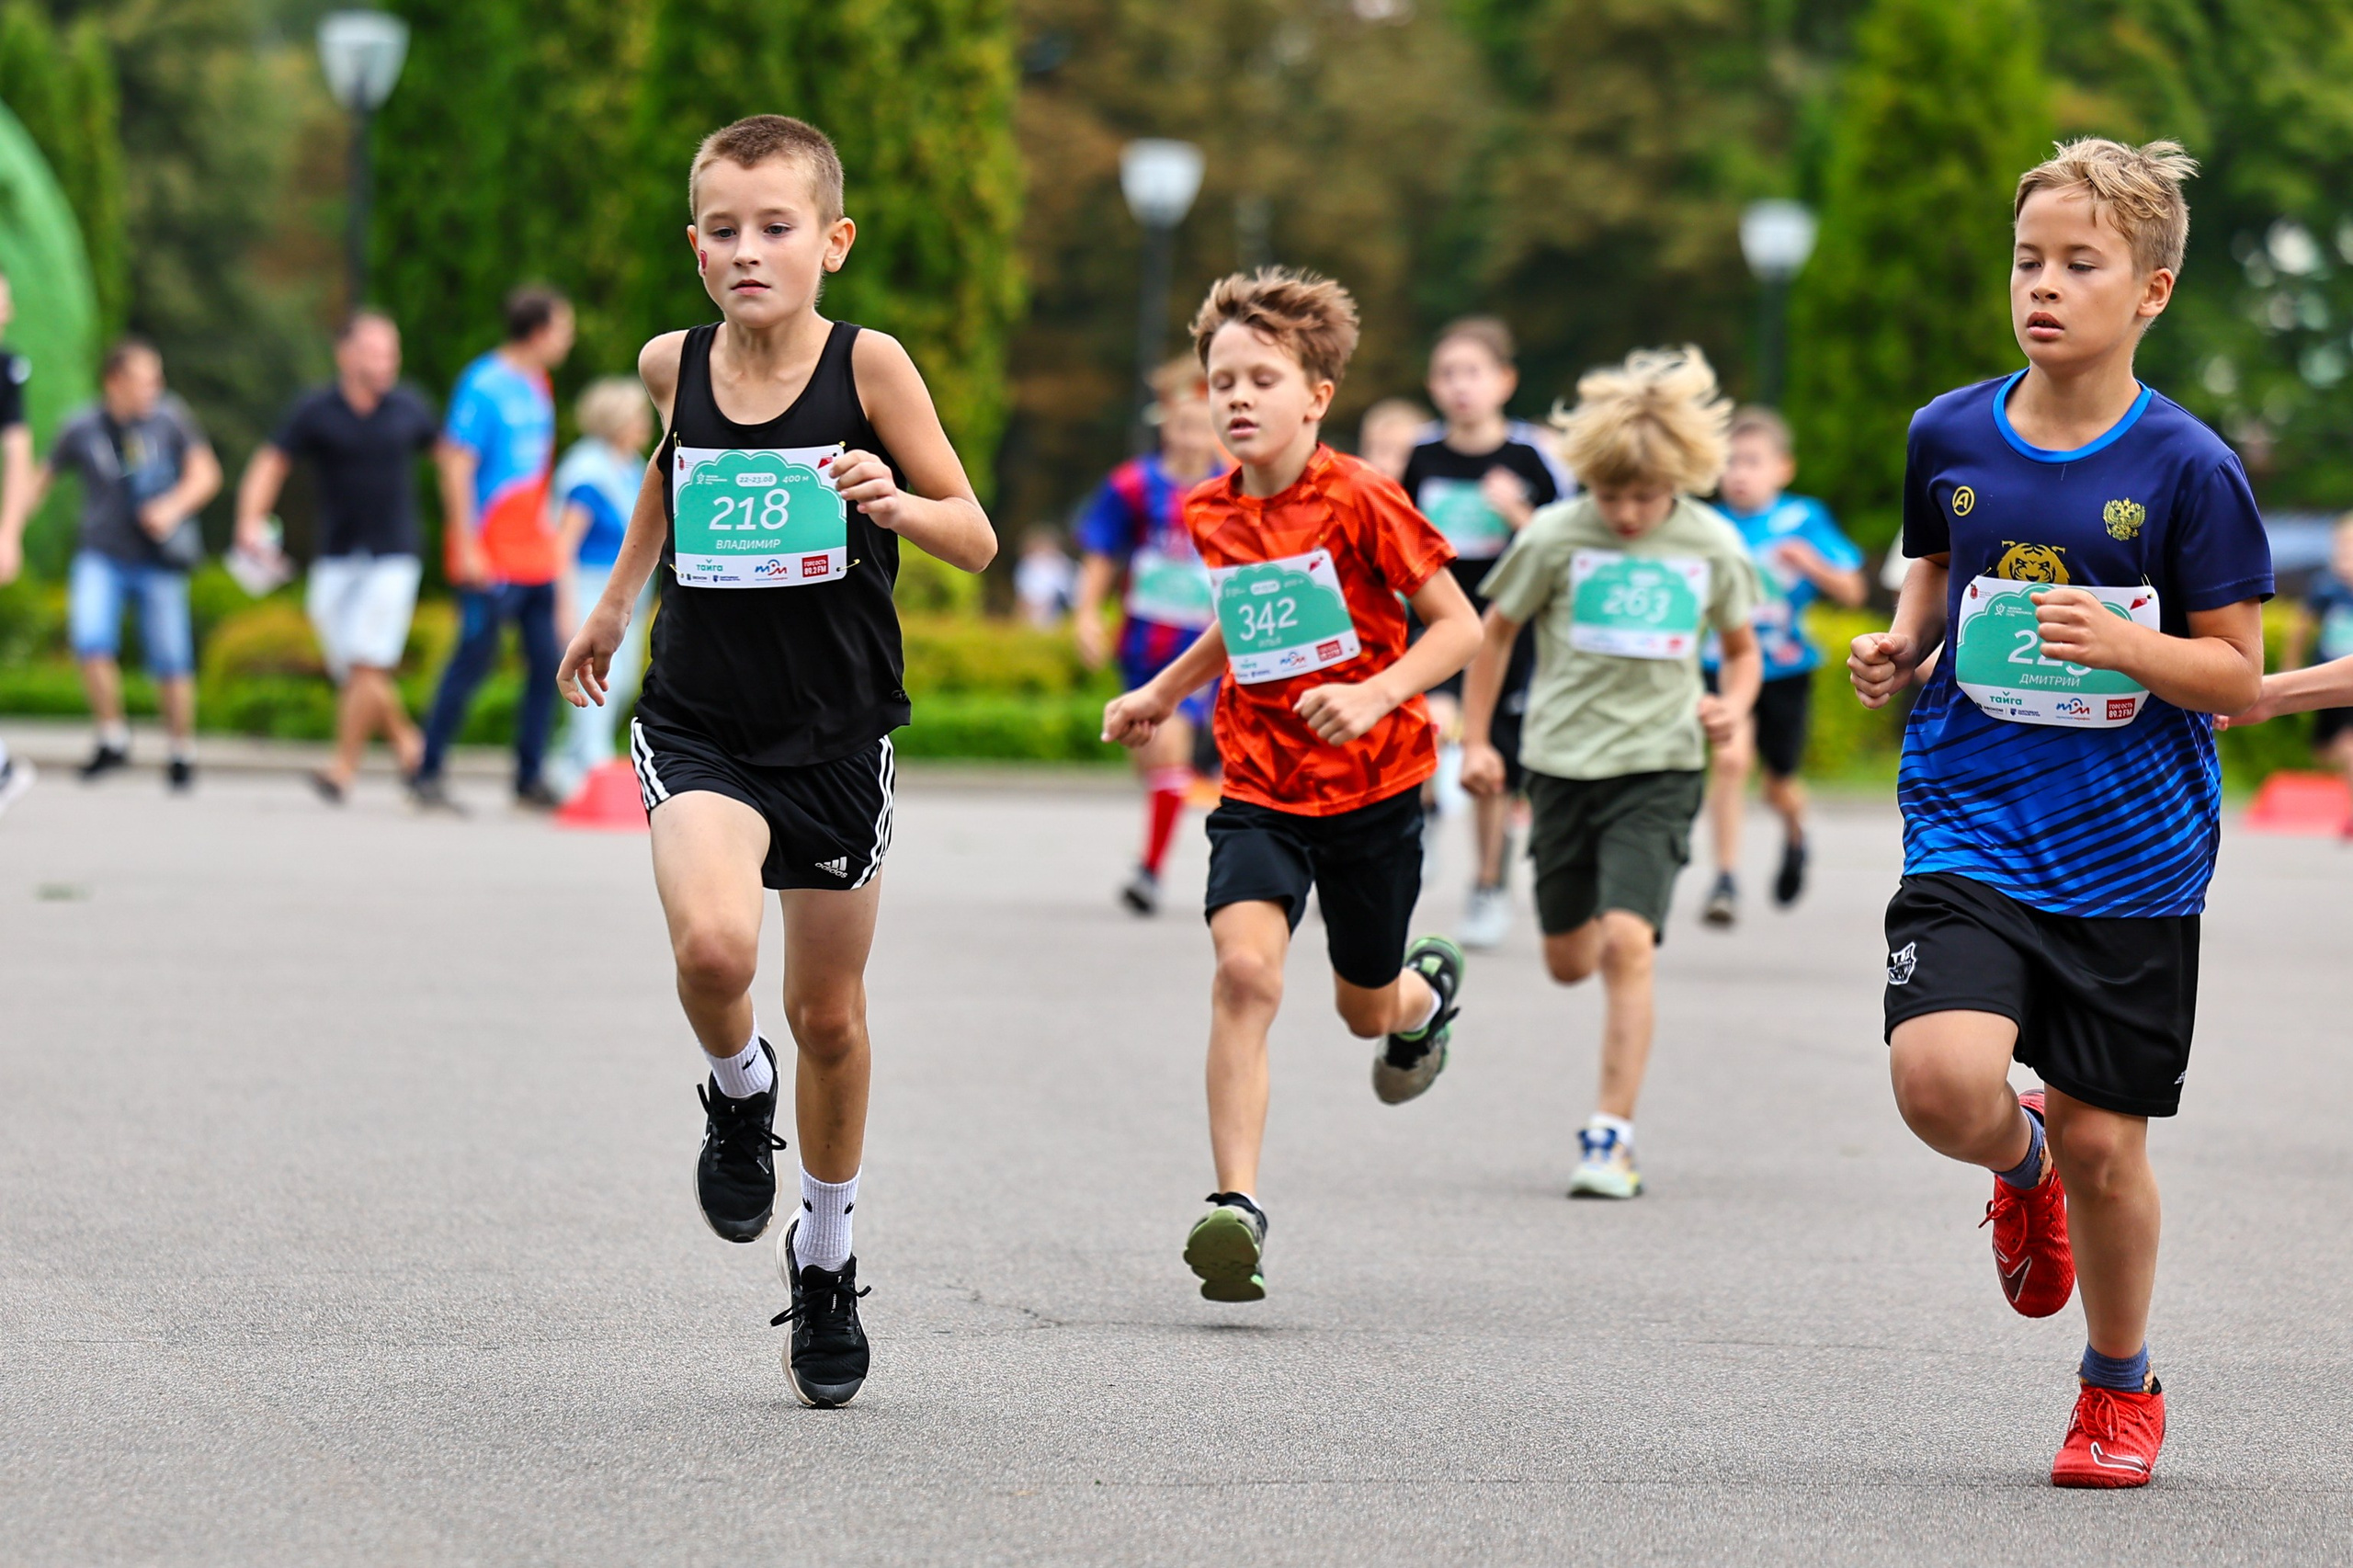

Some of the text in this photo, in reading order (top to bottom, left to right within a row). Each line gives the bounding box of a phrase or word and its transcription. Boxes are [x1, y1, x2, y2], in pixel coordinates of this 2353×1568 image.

[738, 474, 774, 484] 22-23.08
[782, 474, 801, 484] 400
[709, 488, 790, 531] 218
[715, 539, 781, 551] ВЛАДИМИР
[1238, 597, 1299, 642] 342
[2018, 672, 2081, 687] ДМИТРИЙ
[1989, 691, 2023, 706] тайга
[2109, 708, 2133, 719] 89.2 FM
[814, 862, 848, 879] adidas
